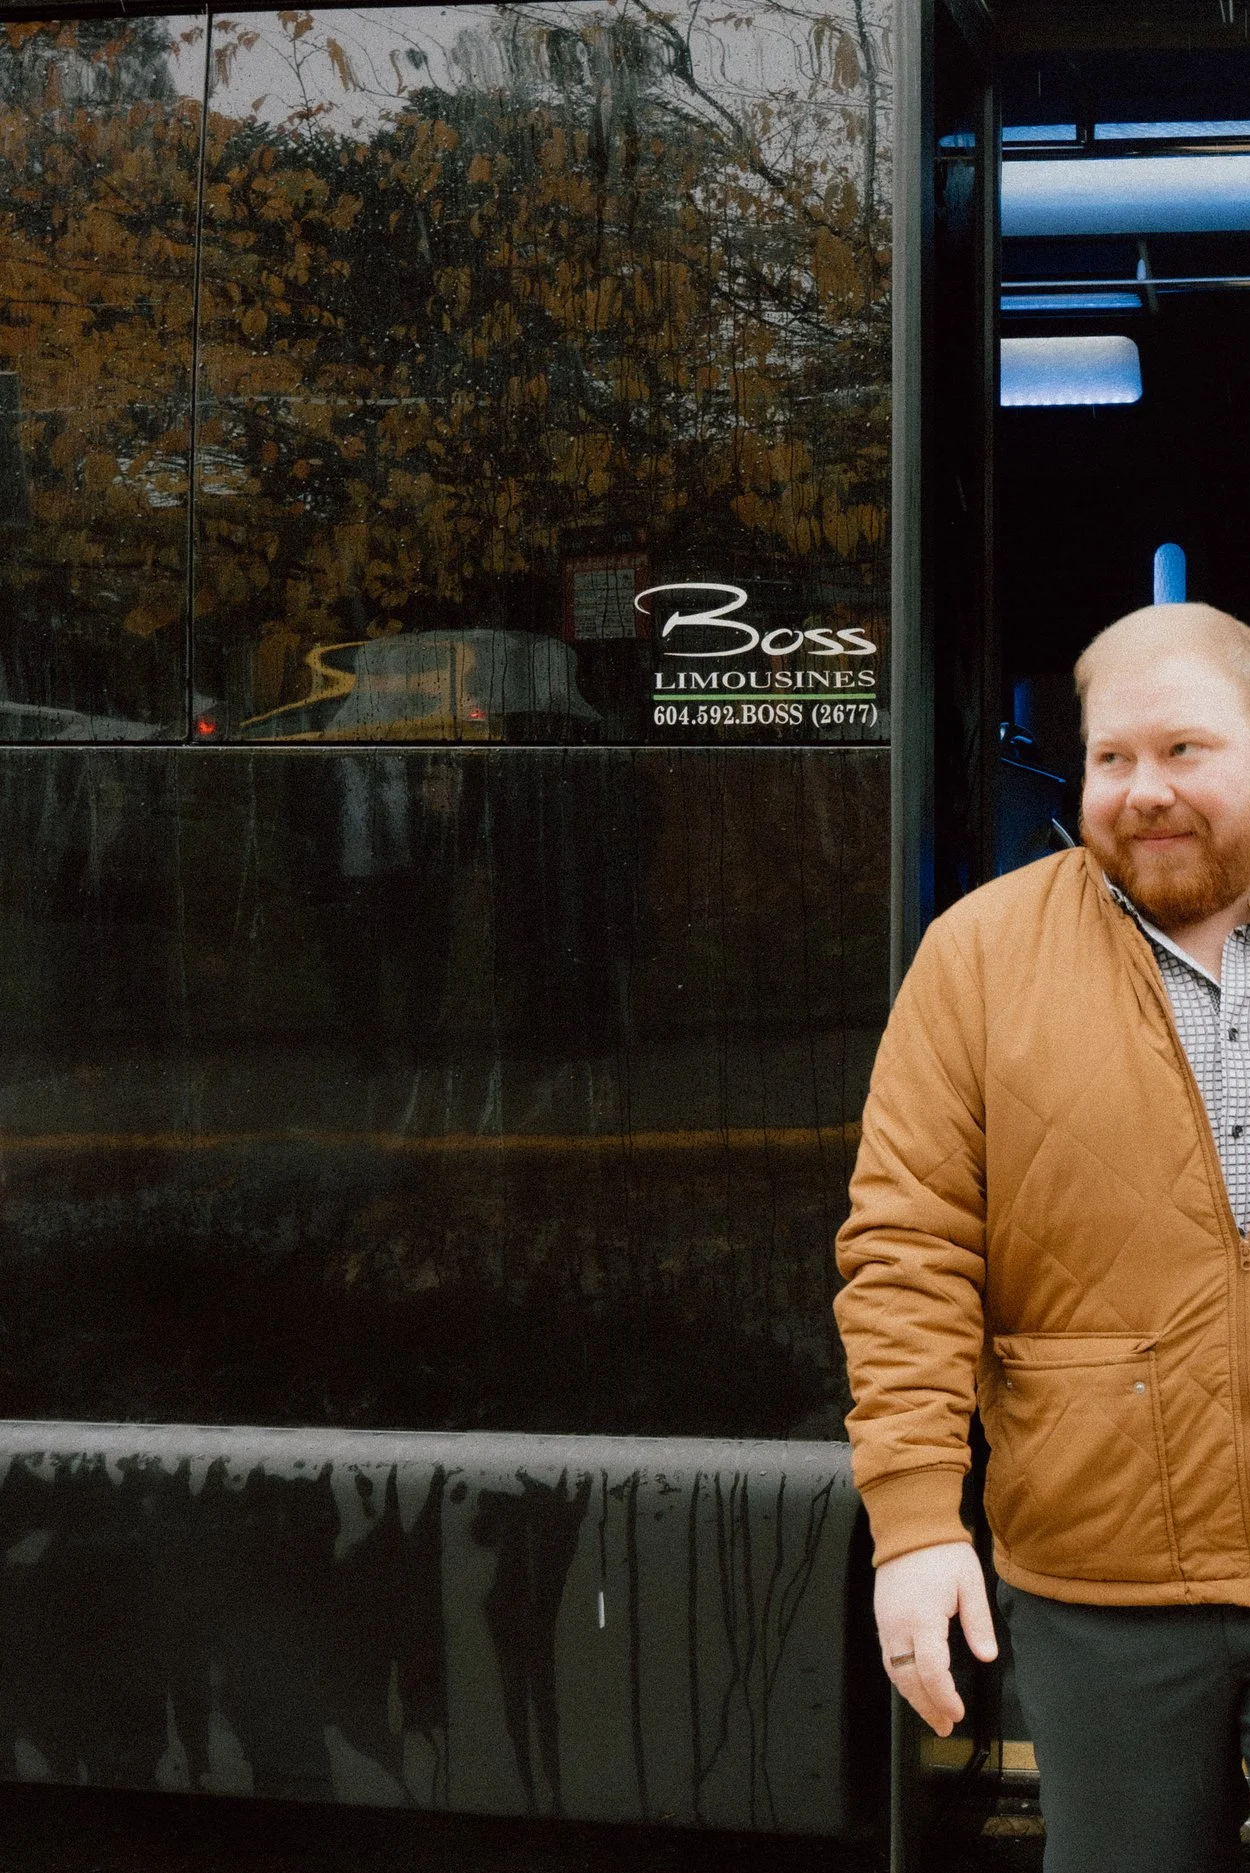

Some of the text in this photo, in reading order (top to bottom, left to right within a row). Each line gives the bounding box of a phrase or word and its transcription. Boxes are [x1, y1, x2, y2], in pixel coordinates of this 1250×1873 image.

[634, 582, 877, 658] Boss
[654, 669, 876, 690] LIMOUSINES
[653, 702, 878, 728] 604.592.BOSS (2677)
